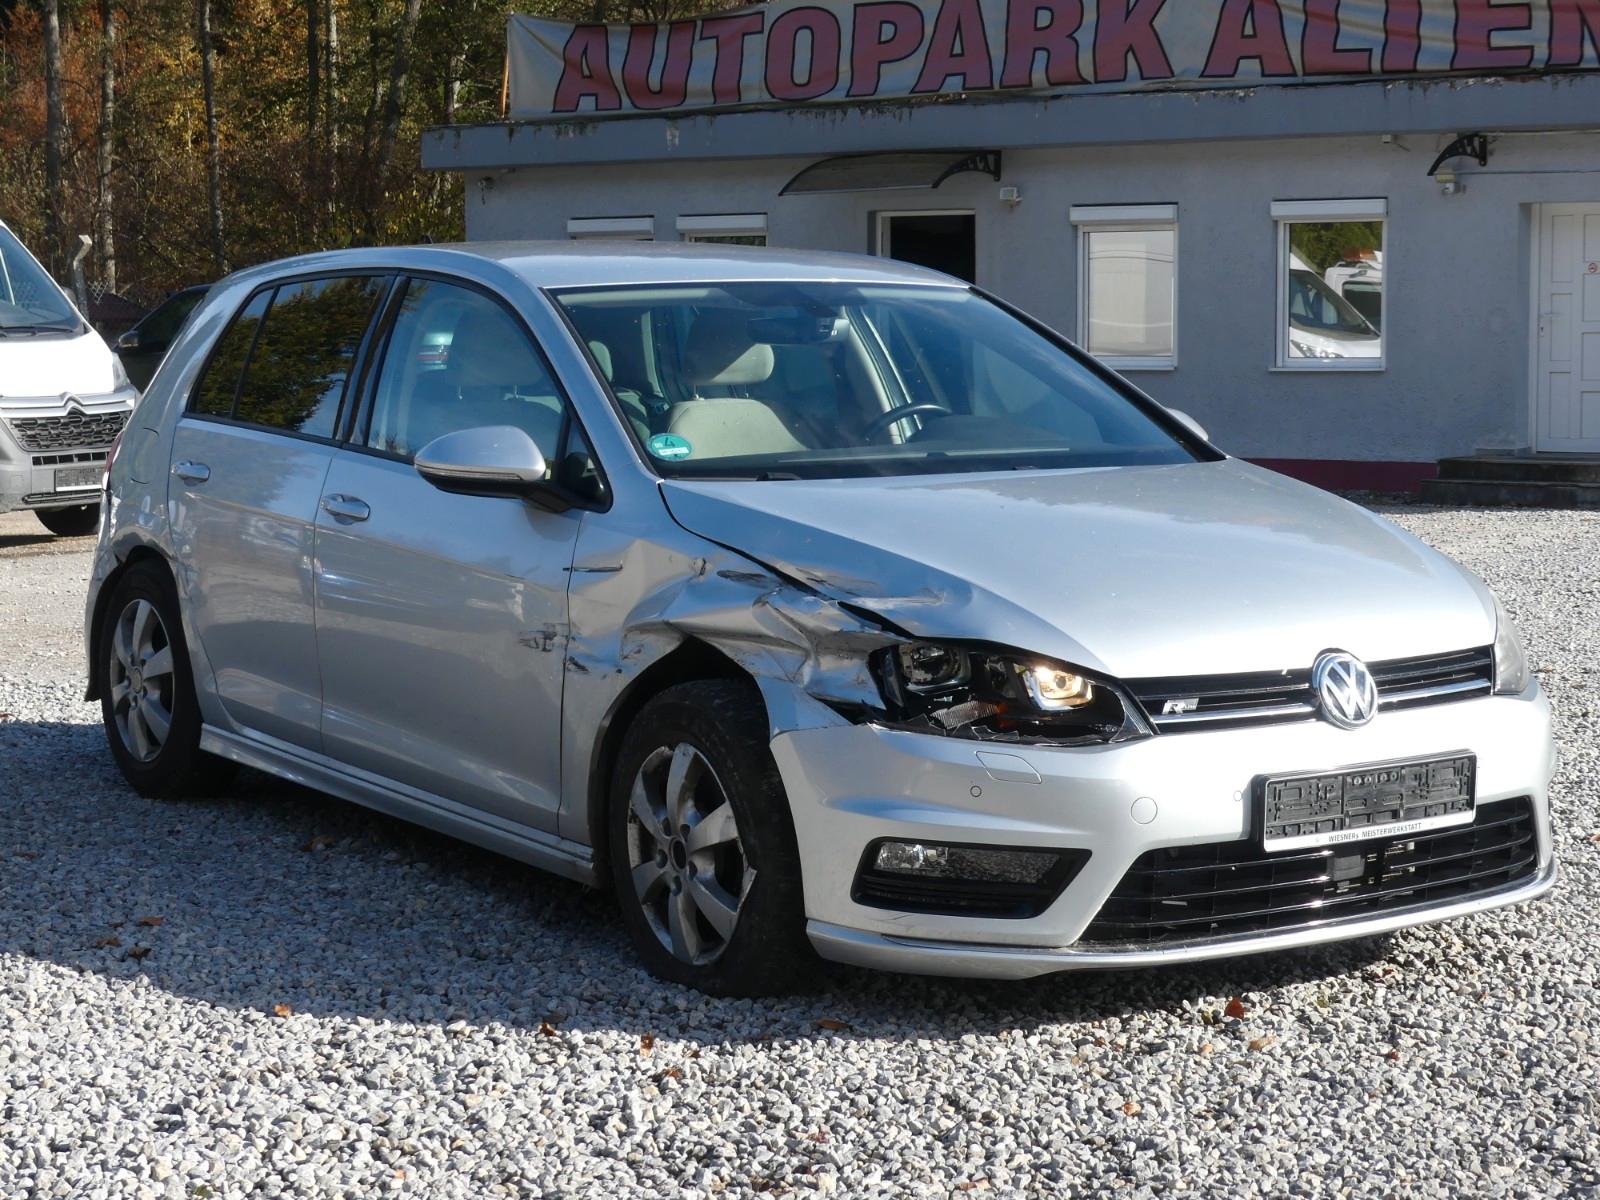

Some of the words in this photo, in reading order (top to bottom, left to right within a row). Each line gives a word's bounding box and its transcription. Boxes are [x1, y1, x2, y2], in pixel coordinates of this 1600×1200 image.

[552, 0, 1175, 113] AUTOPARK
[1318, 652, 1378, 730] VW
[1361, 822, 1422, 838] MEISTERWERKSTATT
